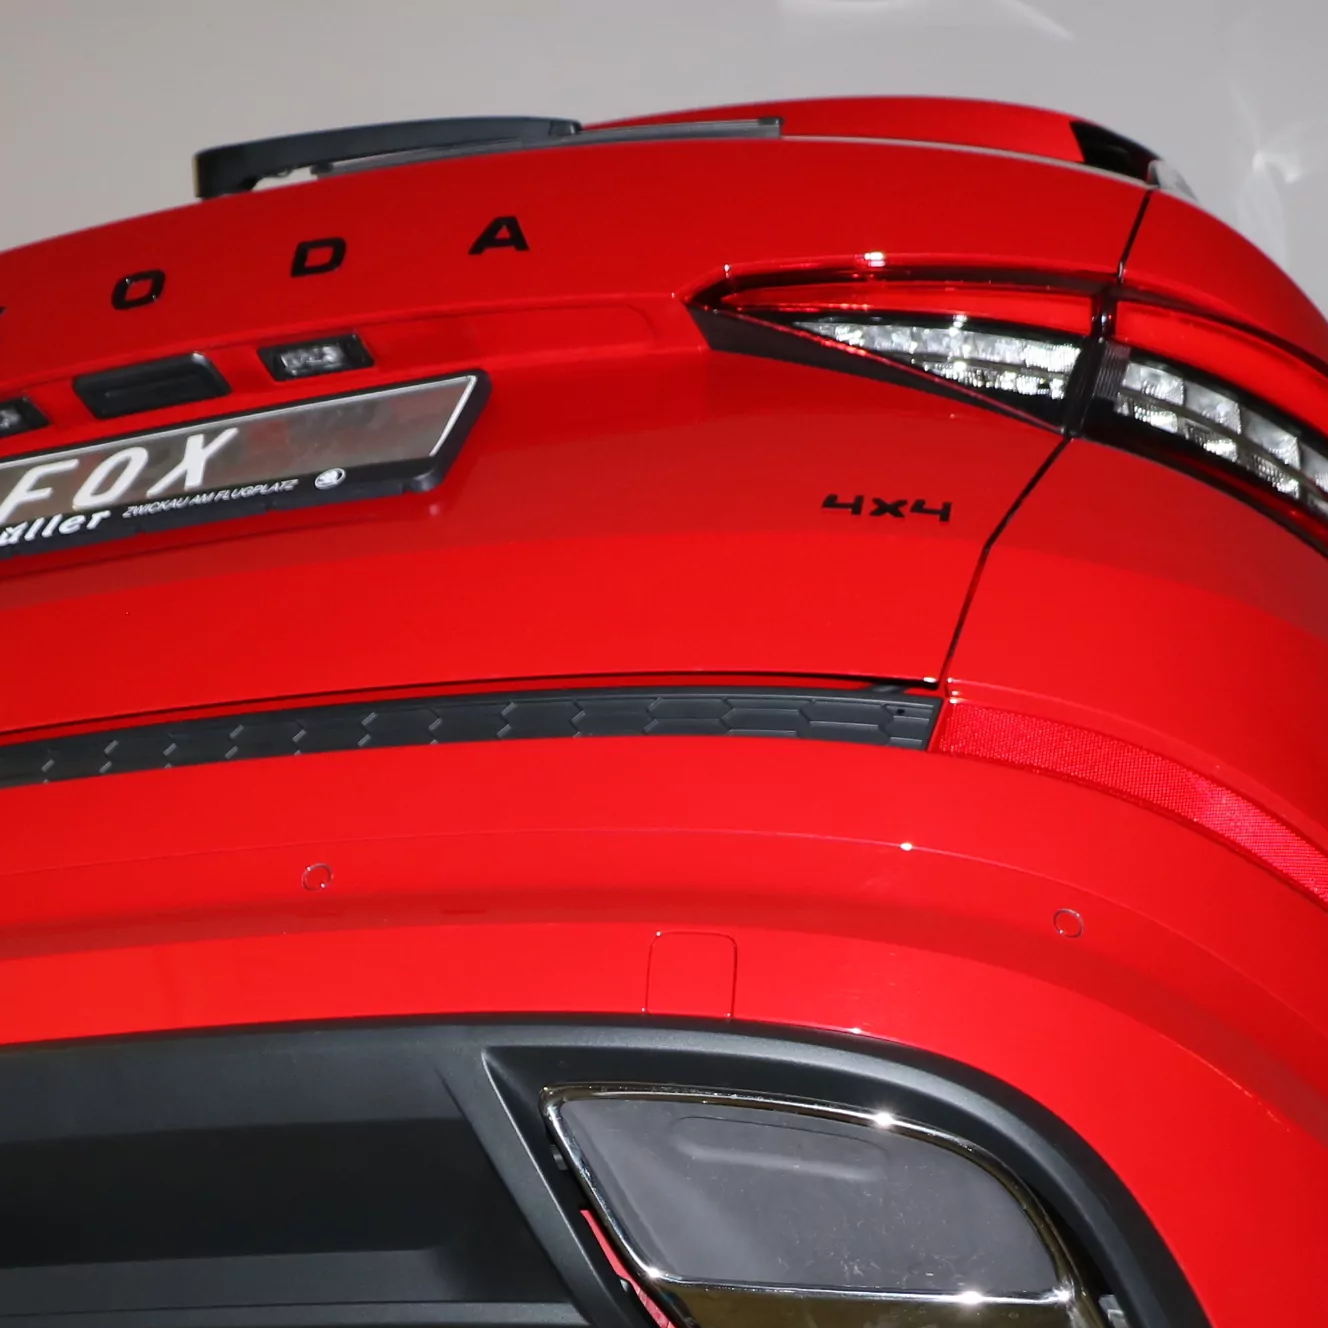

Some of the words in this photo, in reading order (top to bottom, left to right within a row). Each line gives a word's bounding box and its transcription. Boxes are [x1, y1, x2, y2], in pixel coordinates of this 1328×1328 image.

[122, 496, 188, 519] ZWICKAU
[185, 491, 214, 507] AM
[213, 478, 299, 504] FLUGPLATZ
